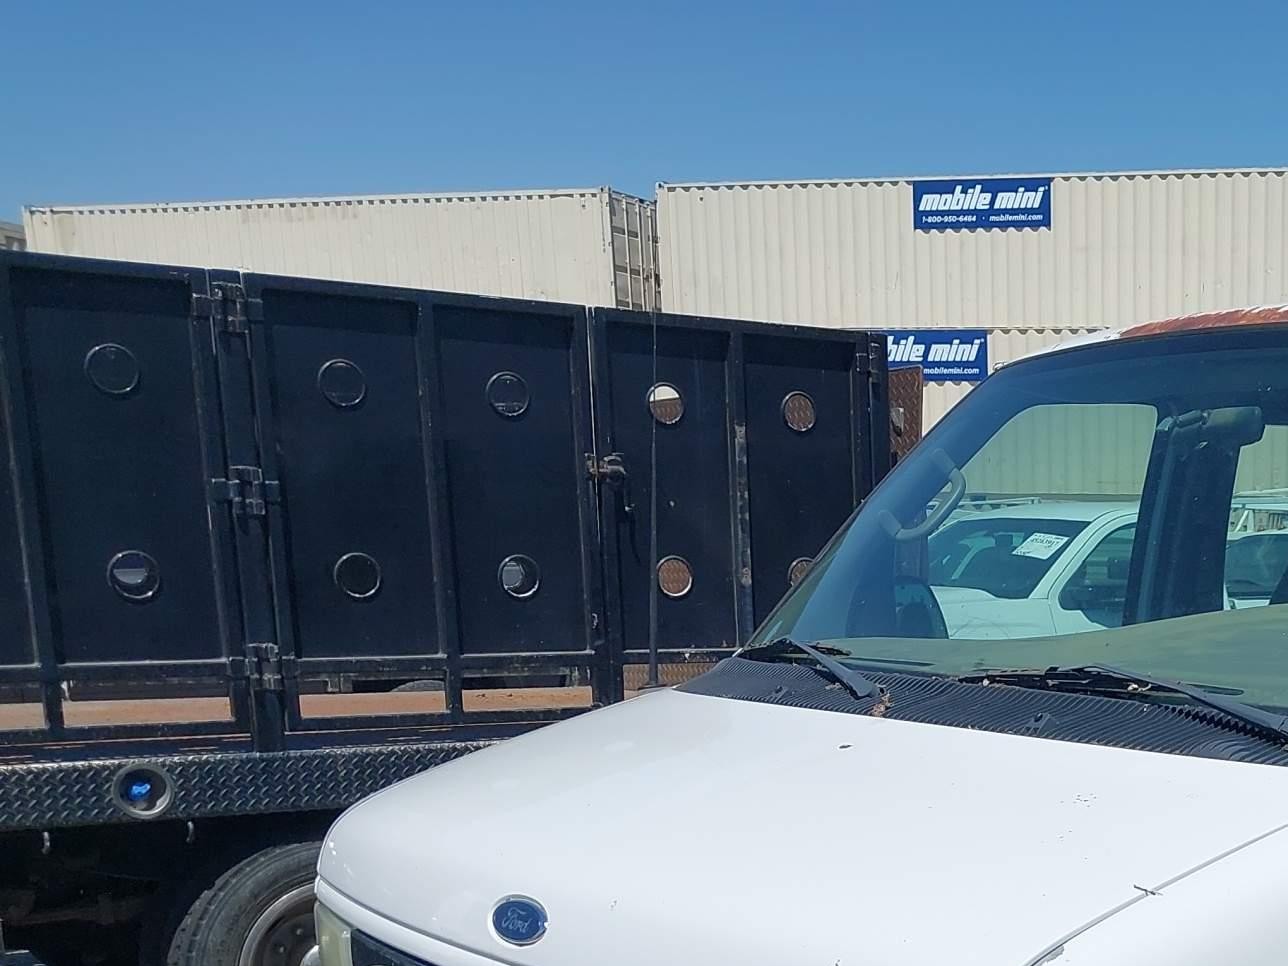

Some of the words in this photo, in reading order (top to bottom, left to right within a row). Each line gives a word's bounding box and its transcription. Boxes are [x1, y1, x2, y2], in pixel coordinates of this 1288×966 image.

[918, 184, 992, 211] mobile
[994, 186, 1045, 209] mini
[922, 214, 977, 223] 1-800-950-6464
[989, 213, 1043, 222] mobilemini.com
[887, 335, 926, 362] bile
[927, 338, 981, 362] mini
[923, 366, 980, 375] mobilemini.com
